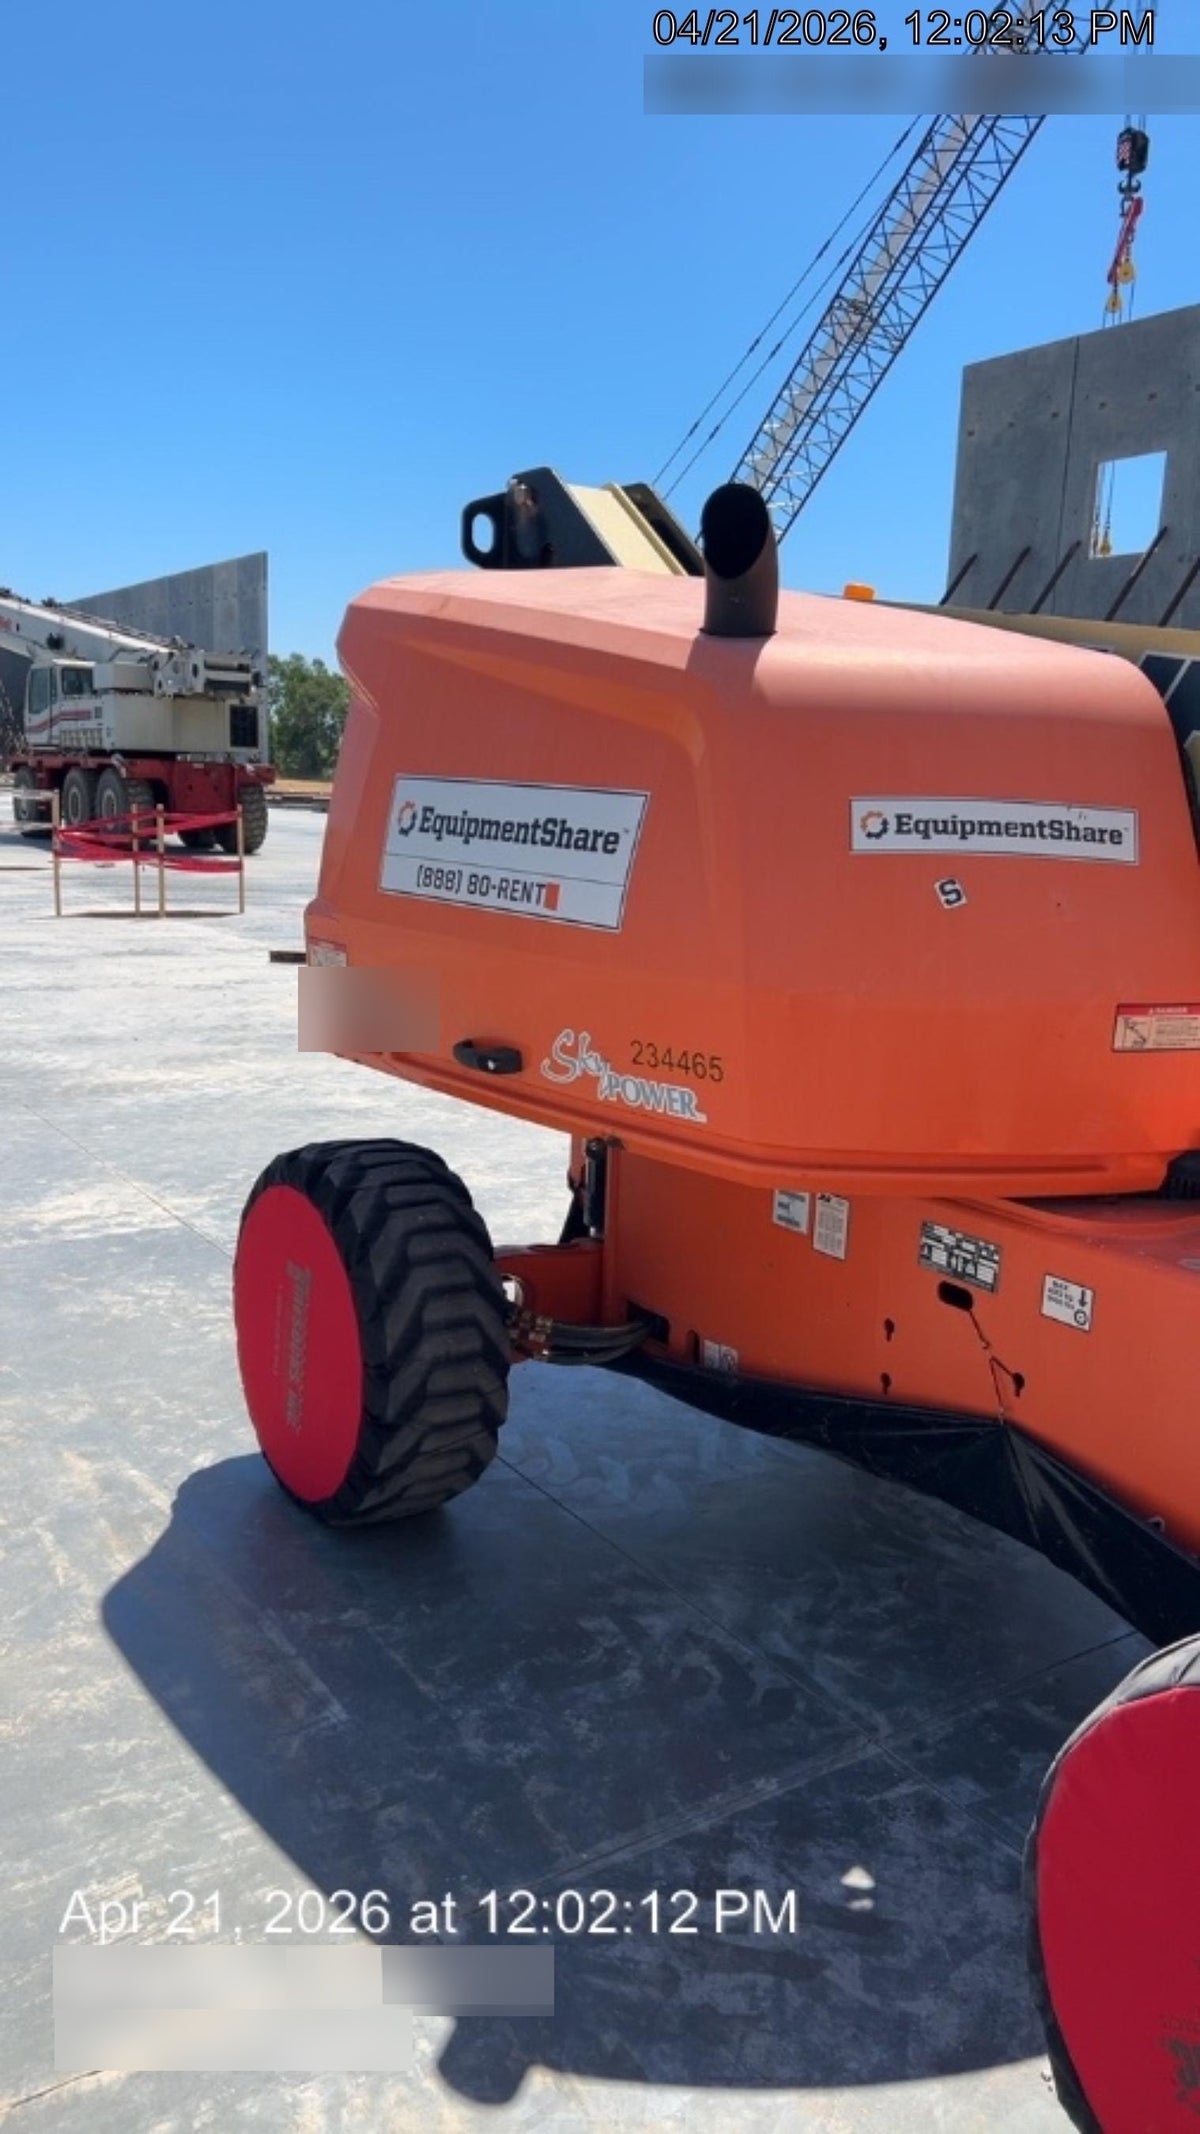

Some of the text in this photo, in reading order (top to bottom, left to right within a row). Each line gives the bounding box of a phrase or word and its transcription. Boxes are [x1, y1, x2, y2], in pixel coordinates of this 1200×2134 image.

[418, 805, 620, 855] EquipmentShare
[894, 813, 1123, 845] EquipmentShare
[416, 864, 546, 905] (888) 80-RENT
[938, 879, 964, 906] S
[630, 1040, 724, 1082] 234465
